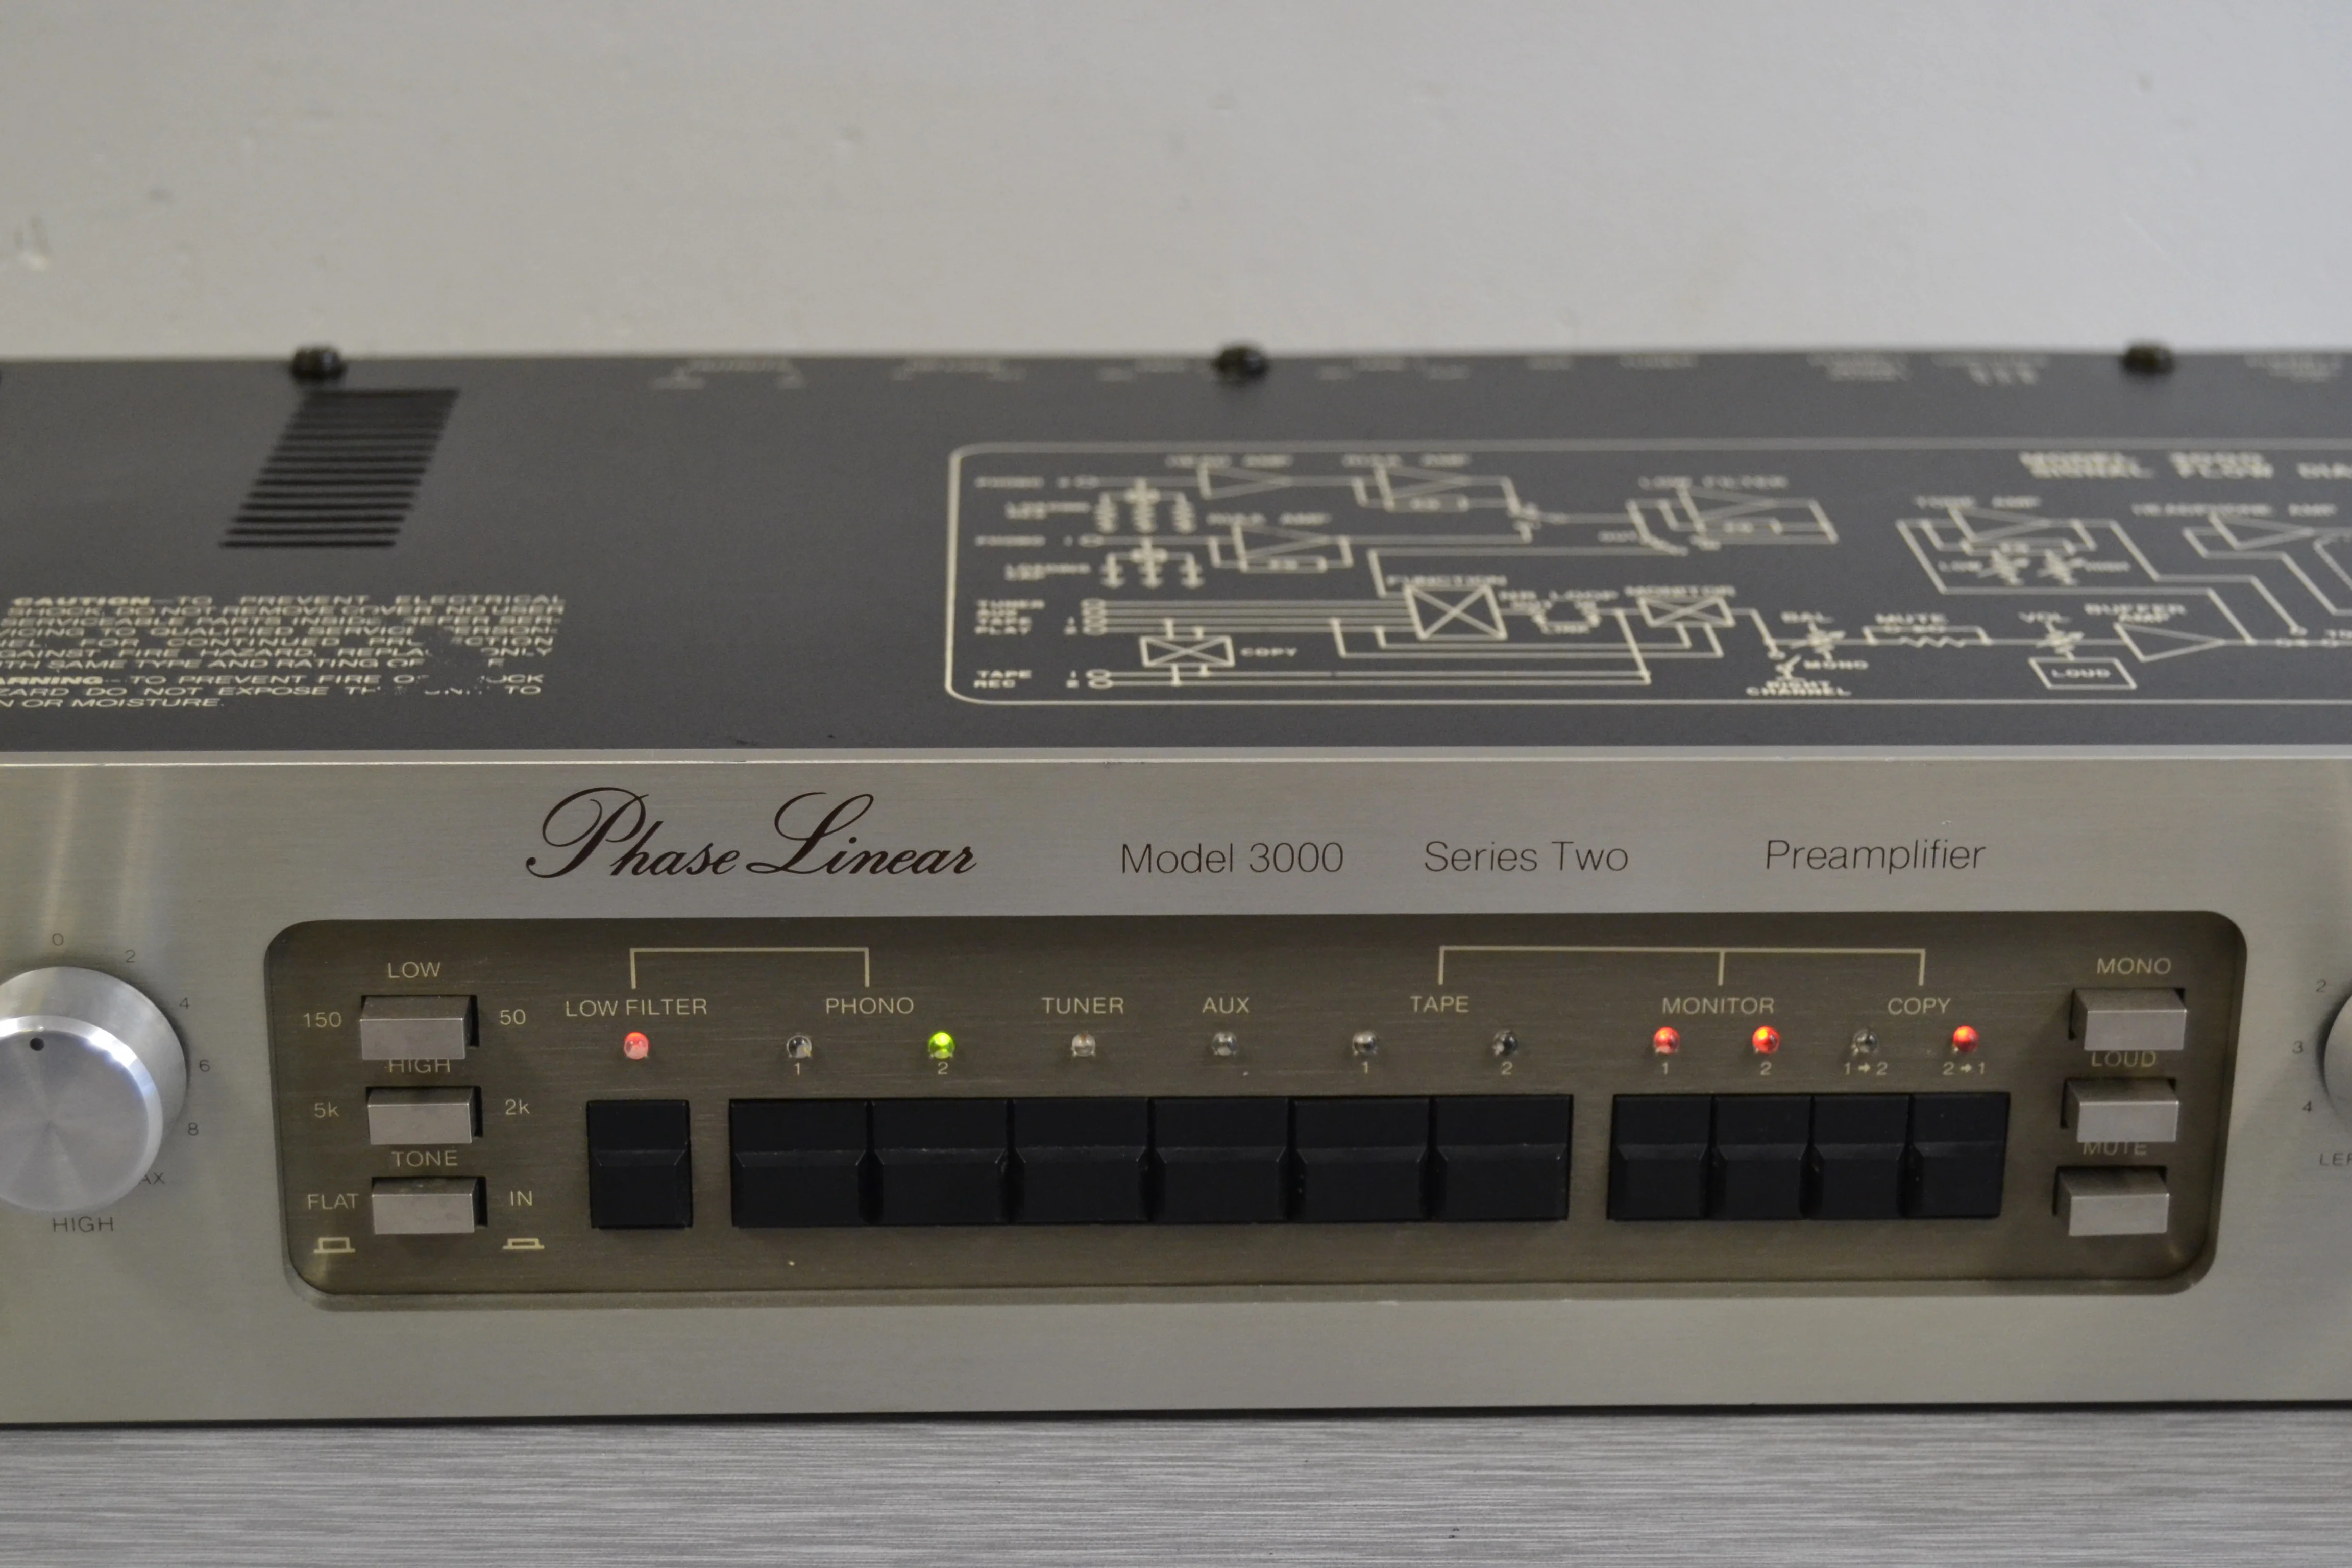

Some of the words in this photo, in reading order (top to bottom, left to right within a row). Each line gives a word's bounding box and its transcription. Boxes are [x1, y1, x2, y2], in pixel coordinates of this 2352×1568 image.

[1239, 646, 1298, 657] COPY
[207, 658, 269, 669] AND
[276, 657, 379, 668] RATING
[130, 675, 167, 685] TO
[179, 675, 307, 685] PREVENT
[318, 674, 382, 684] FIRE
[2051, 668, 2111, 678] LOUD
[86, 687, 128, 697] DO
[144, 687, 204, 697] NOT
[218, 685, 330, 696] EXPOSE
[504, 685, 542, 695] TO
[22, 698, 64, 708] OR
[525, 787, 738, 879] Phase
[746, 792, 977, 876] Linear
[1121, 842, 1233, 874] Model
[1249, 842, 1344, 873] 3000
[1425, 841, 1538, 872] Series
[1551, 841, 1629, 872] Two
[1766, 839, 1987, 875] Preamplifier
[125, 949, 136, 964] 2
[387, 962, 440, 979] LOW
[2096, 957, 2172, 975] MONO
[2316, 979, 2328, 993] 2
[179, 997, 190, 1010] 4
[565, 999, 619, 1017] LOW
[625, 998, 708, 1016] FILTER
[825, 997, 915, 1015] PHONO
[1041, 996, 1124, 1014] TUNER
[1202, 996, 1251, 1014] AUX
[1410, 995, 1469, 1013] TAPE
[1661, 997, 1775, 1015] MONITOR
[1887, 997, 1951, 1015] COPY
[303, 1011, 342, 1028] 150
[500, 1009, 526, 1026] 50
[2292, 1040, 2304, 1055] 3
[199, 1059, 211, 1073] 6
[388, 1059, 451, 1073] HIGH
[2091, 1050, 2158, 1068] LOUD
[795, 1062, 801, 1075] 1
[937, 1062, 949, 1075] 2
[1362, 1061, 1369, 1075] 1
[1501, 1061, 1513, 1075] 2
[1662, 1062, 1669, 1075] 1
[1760, 1062, 1772, 1075] 2
[314, 1102, 339, 1118] 5k
[505, 1098, 530, 1116] 2k
[2302, 1100, 2313, 1113] 4
[187, 1122, 199, 1137] 8
[2082, 1142, 2147, 1156] MUTE
[391, 1150, 458, 1167] TONE
[307, 1193, 359, 1210] FLAT
[510, 1190, 533, 1207] IN
[52, 1216, 114, 1233] HIGH
